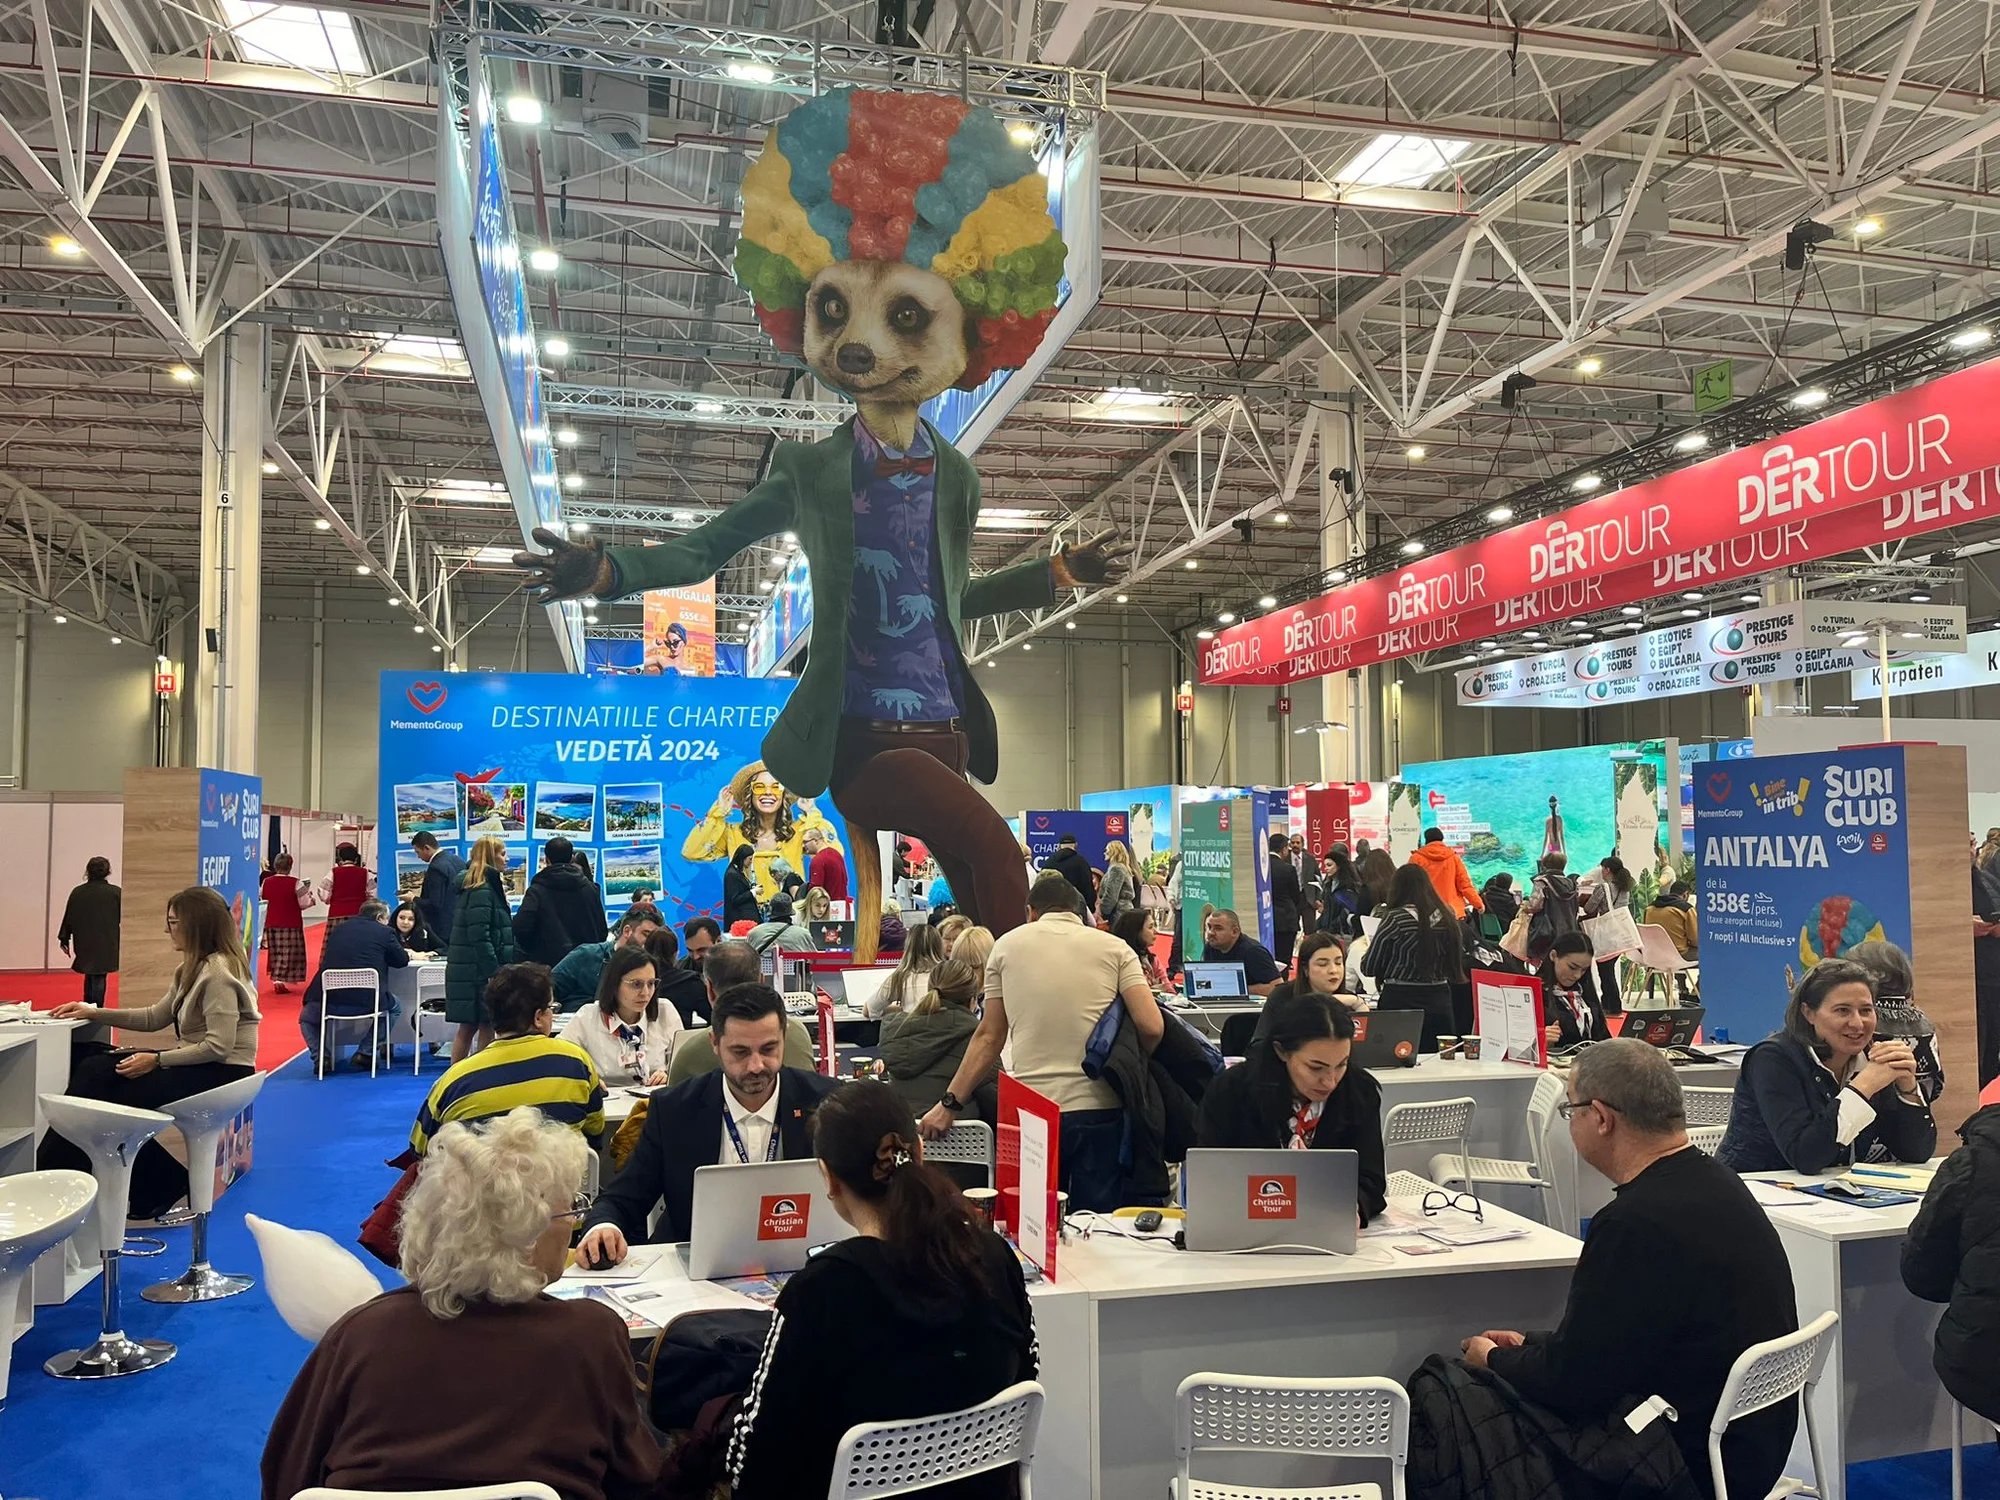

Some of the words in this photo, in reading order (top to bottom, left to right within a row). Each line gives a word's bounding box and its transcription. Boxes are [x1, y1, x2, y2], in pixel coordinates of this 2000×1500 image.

[1738, 413, 1952, 525] DERTOUR
[221, 493, 229, 504] 6
[1351, 545, 1358, 555] 4
[1530, 504, 1672, 584] DERTOUR
[650, 589, 712, 604] ORTUGALIA
[1388, 562, 1487, 625] DERTOUR
[1746, 613, 1794, 634] PRESTIGE
[1830, 616, 1856, 625] TURCIA
[1930, 618, 1954, 626] EXOTICE
[1284, 604, 1358, 655] DERTOUR
[1657, 628, 1693, 645] EXOTICE
[1930, 633, 1960, 641] BULGARIA
[1753, 630, 1788, 646] TOURS
[1205, 635, 1262, 677] DERTOUR
[1602, 646, 1638, 662] PRESTIGE
[1658, 642, 1683, 657] EGIPT
[1805, 648, 1832, 662] EGIPT
[1539, 658, 1566, 673] TURCIA
[1607, 658, 1633, 672] TOURS
[1659, 652, 1702, 670] BULGARIA
[1741, 651, 1781, 666] PRESTIGE
[1805, 656, 1854, 673] BULGARIA
[1484, 670, 1513, 683] PRESTIGE
[1747, 663, 1776, 676] TOURS
[1873, 664, 1943, 688] Krpaten
[1488, 681, 1509, 693] TOURS
[1525, 671, 1567, 688] CROAZIERE
[1655, 676, 1701, 692] CROAZIERE
[1613, 685, 1637, 696] TOURS
[491, 706, 659, 728] DESTINATIILE
[668, 706, 779, 728] CHARTER
[390, 720, 464, 732] MementoGroup
[555, 733, 653, 763] VEDETĂ
[658, 739, 720, 762] 2024
[1823, 765, 1893, 799] SURI
[242, 788, 260, 816] SURI
[1698, 808, 1744, 819] MementoGroup
[1824, 798, 1898, 828] CLUB
[241, 816, 260, 840] CLUB
[1033, 843, 1060, 854] CHAR
[1703, 835, 1829, 868] ANTALYA
[1184, 850, 1199, 867] CITY
[1201, 850, 1231, 869] BREAKS
[202, 855, 231, 887] EGIPT
[1706, 878, 1717, 889] de
[1719, 878, 1727, 889] la
[1706, 915, 1724, 925] (taxe
[1724, 917, 1754, 927] aeroport
[1754, 918, 1783, 929] incluse)
[1709, 931, 1713, 940] 7
[1739, 933, 1750, 944] All
[1751, 934, 1785, 946] Inclusive
[1252, 1198, 1292, 1206] Christian
[763, 1217, 803, 1227] Christian
